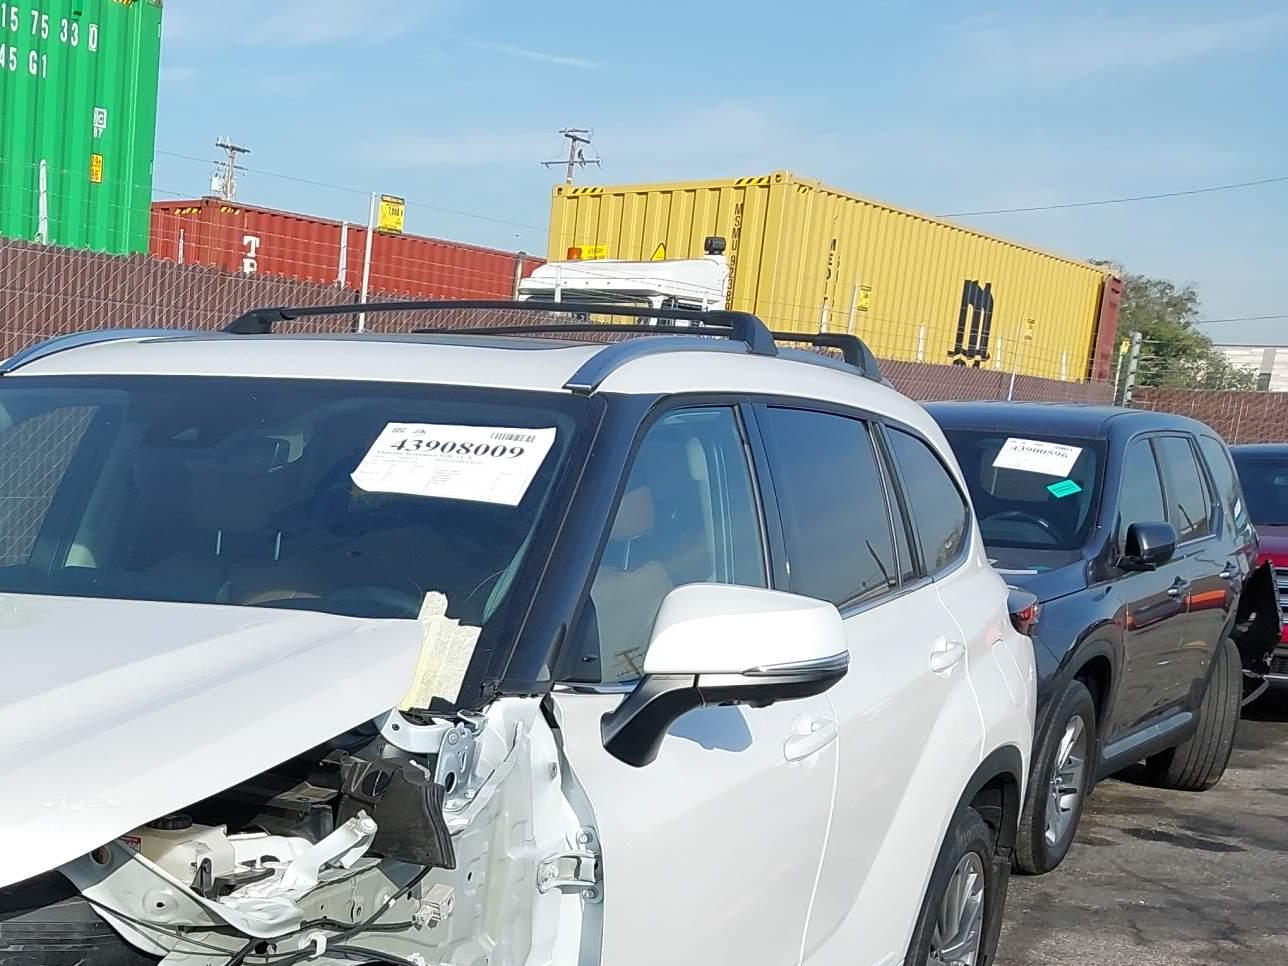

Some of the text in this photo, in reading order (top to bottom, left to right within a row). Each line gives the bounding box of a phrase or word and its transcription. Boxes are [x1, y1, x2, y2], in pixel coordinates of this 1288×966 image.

[1, 3, 19, 32] 15
[31, 9, 49, 40] 75
[60, 18, 79, 47] 33
[29, 50, 48, 79] G1
[390, 438, 525, 459] 43908009
